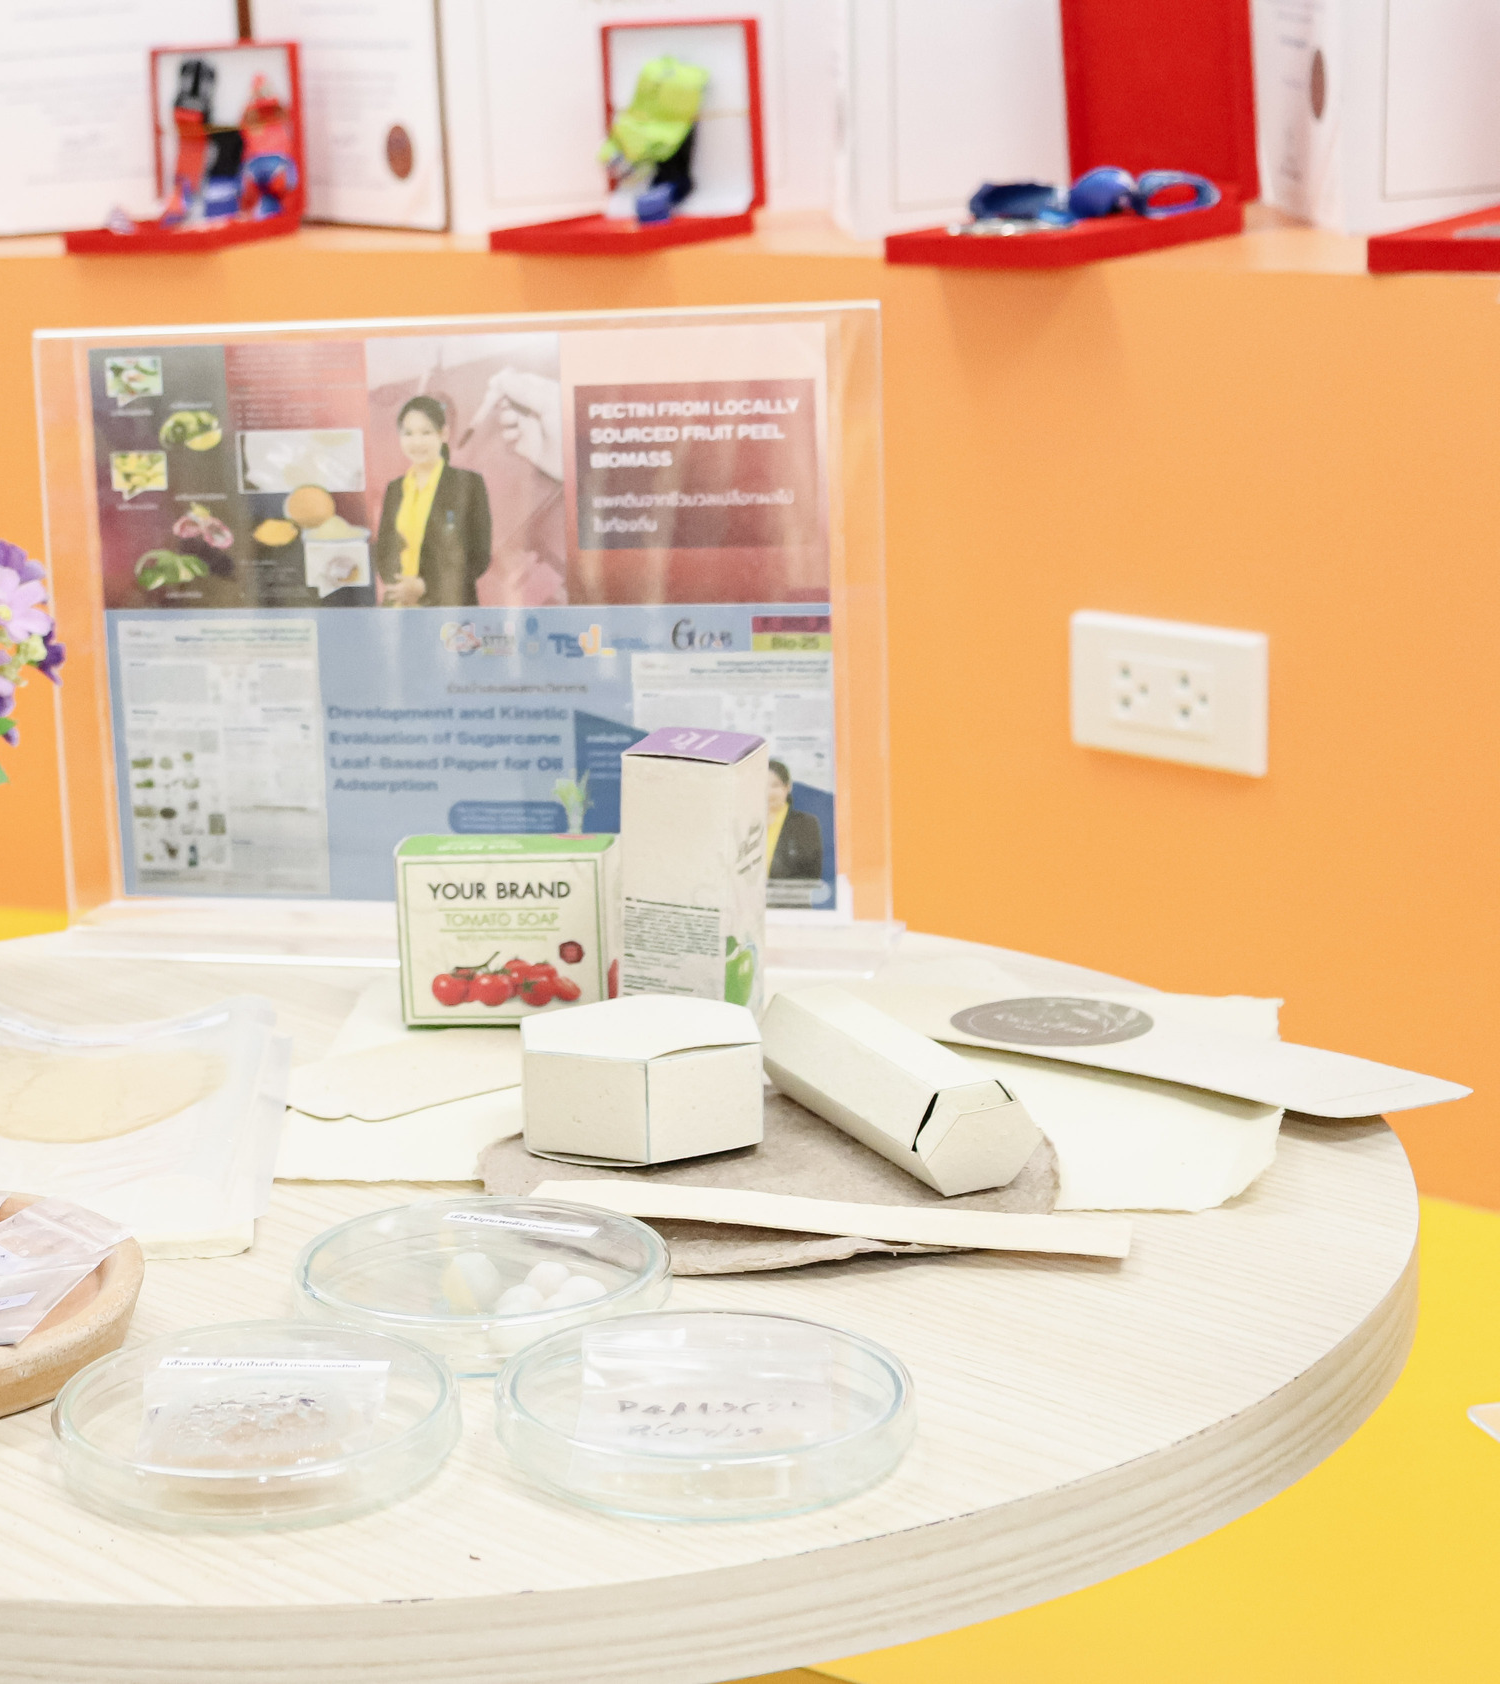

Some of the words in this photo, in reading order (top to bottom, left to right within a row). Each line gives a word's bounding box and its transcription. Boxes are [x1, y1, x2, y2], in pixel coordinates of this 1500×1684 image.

[588, 402, 656, 419] PECTIN
[657, 400, 711, 417] FROM
[712, 398, 799, 416] LOCALLY
[589, 426, 679, 444] SOURCED
[681, 424, 735, 441] FRUIT
[737, 423, 786, 440] PEEL
[589, 451, 673, 469] BIOMASS
[327, 706, 454, 722] Development
[459, 706, 496, 720] and
[501, 706, 569, 720] Kinetic
[328, 730, 428, 745] Evaluation
[432, 730, 453, 745] of
[456, 730, 561, 748] Sugarcane
[443, 757, 499, 772] Paper
[504, 756, 531, 770] for
[537, 757, 564, 771] Oil
[333, 778, 439, 793] Adsorption
[428, 882, 486, 900] YOUR
[496, 881, 571, 900] BRAND
[444, 912, 512, 927] TOMATO
[517, 911, 559, 926] SOAP
